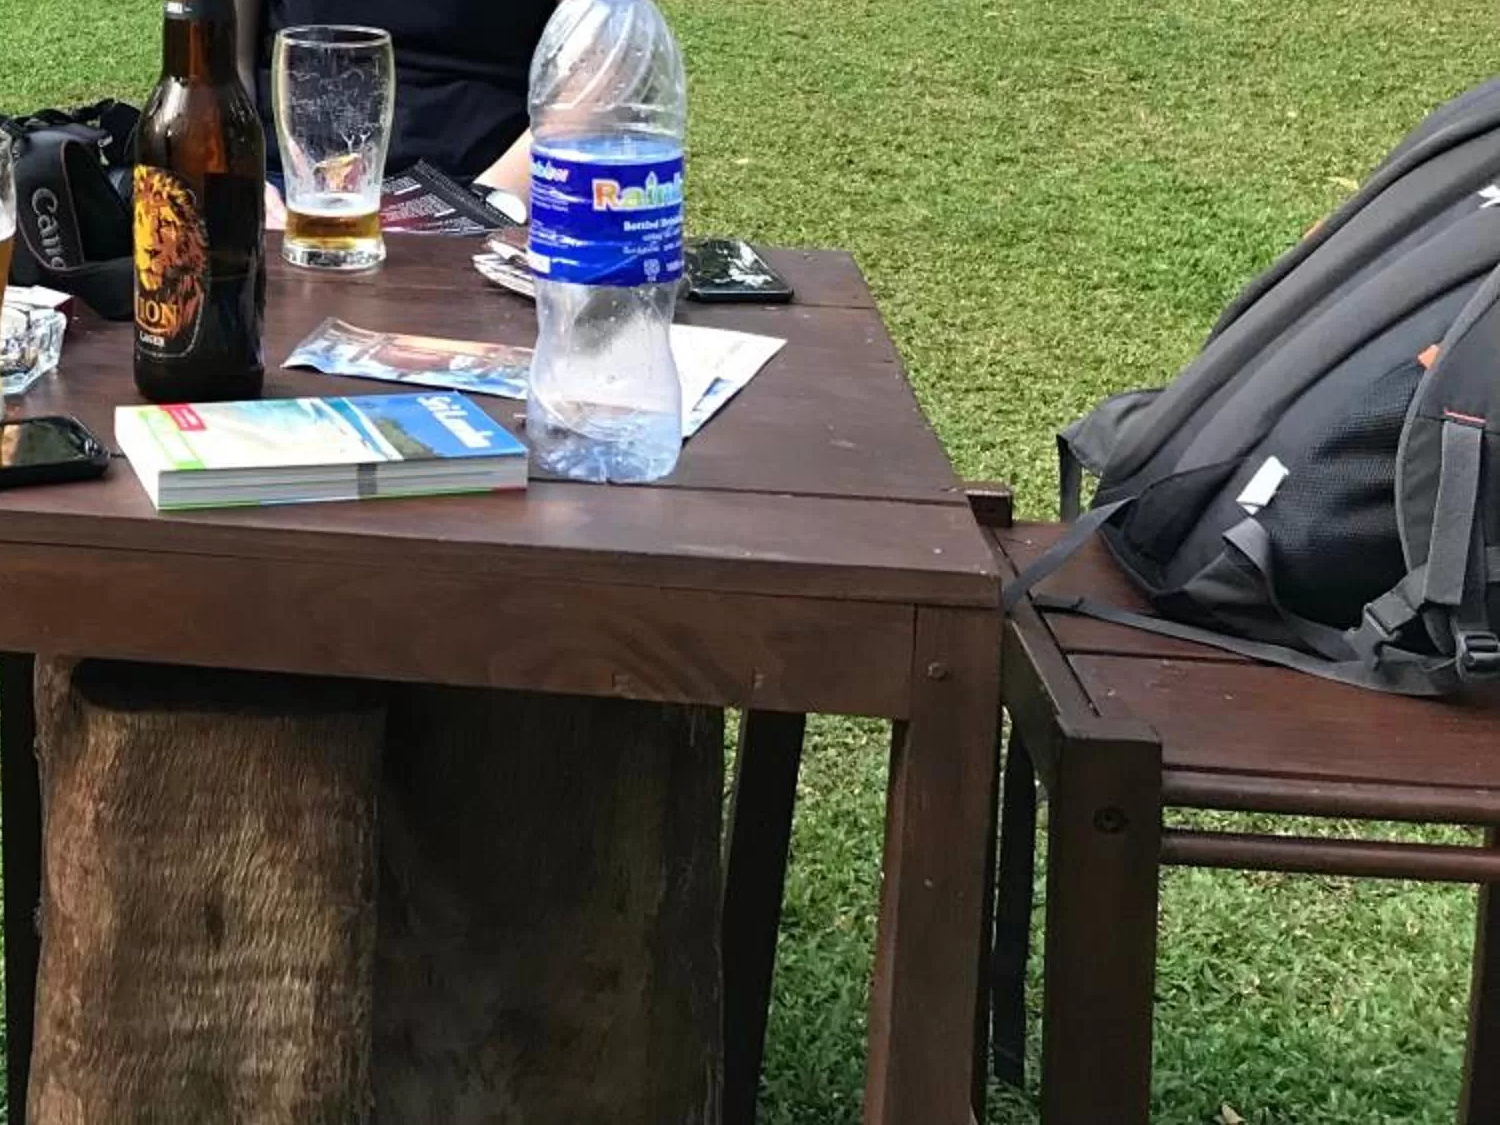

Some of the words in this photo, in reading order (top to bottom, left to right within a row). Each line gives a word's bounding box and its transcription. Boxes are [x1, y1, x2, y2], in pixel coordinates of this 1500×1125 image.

[592, 171, 683, 211] Rainb
[31, 187, 67, 269] Cano
[134, 296, 177, 325] ION
